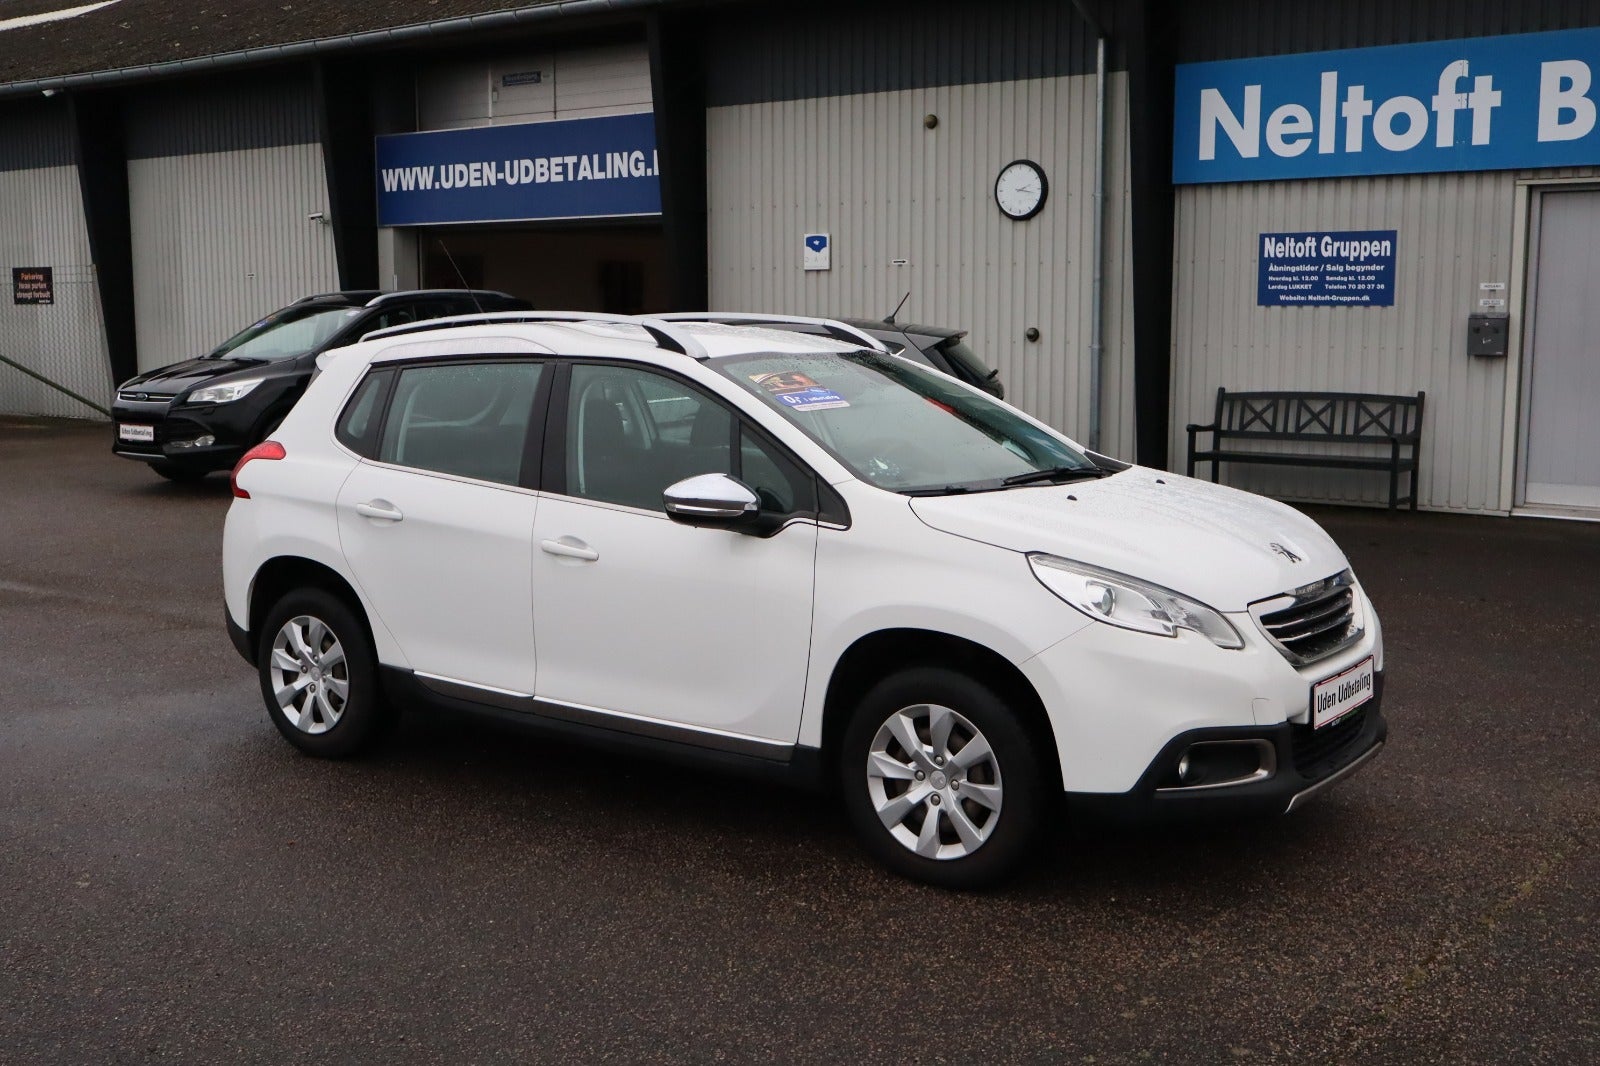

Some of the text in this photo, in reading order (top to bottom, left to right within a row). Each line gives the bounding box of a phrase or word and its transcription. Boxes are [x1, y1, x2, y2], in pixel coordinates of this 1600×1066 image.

[1199, 59, 1502, 161] Neltoft
[1264, 235, 1391, 261] Neltoft Gruppen
[1268, 263, 1319, 272] Åbningstider
[1325, 264, 1344, 272] Salg
[1317, 673, 1371, 713] Uden Udbetaling
